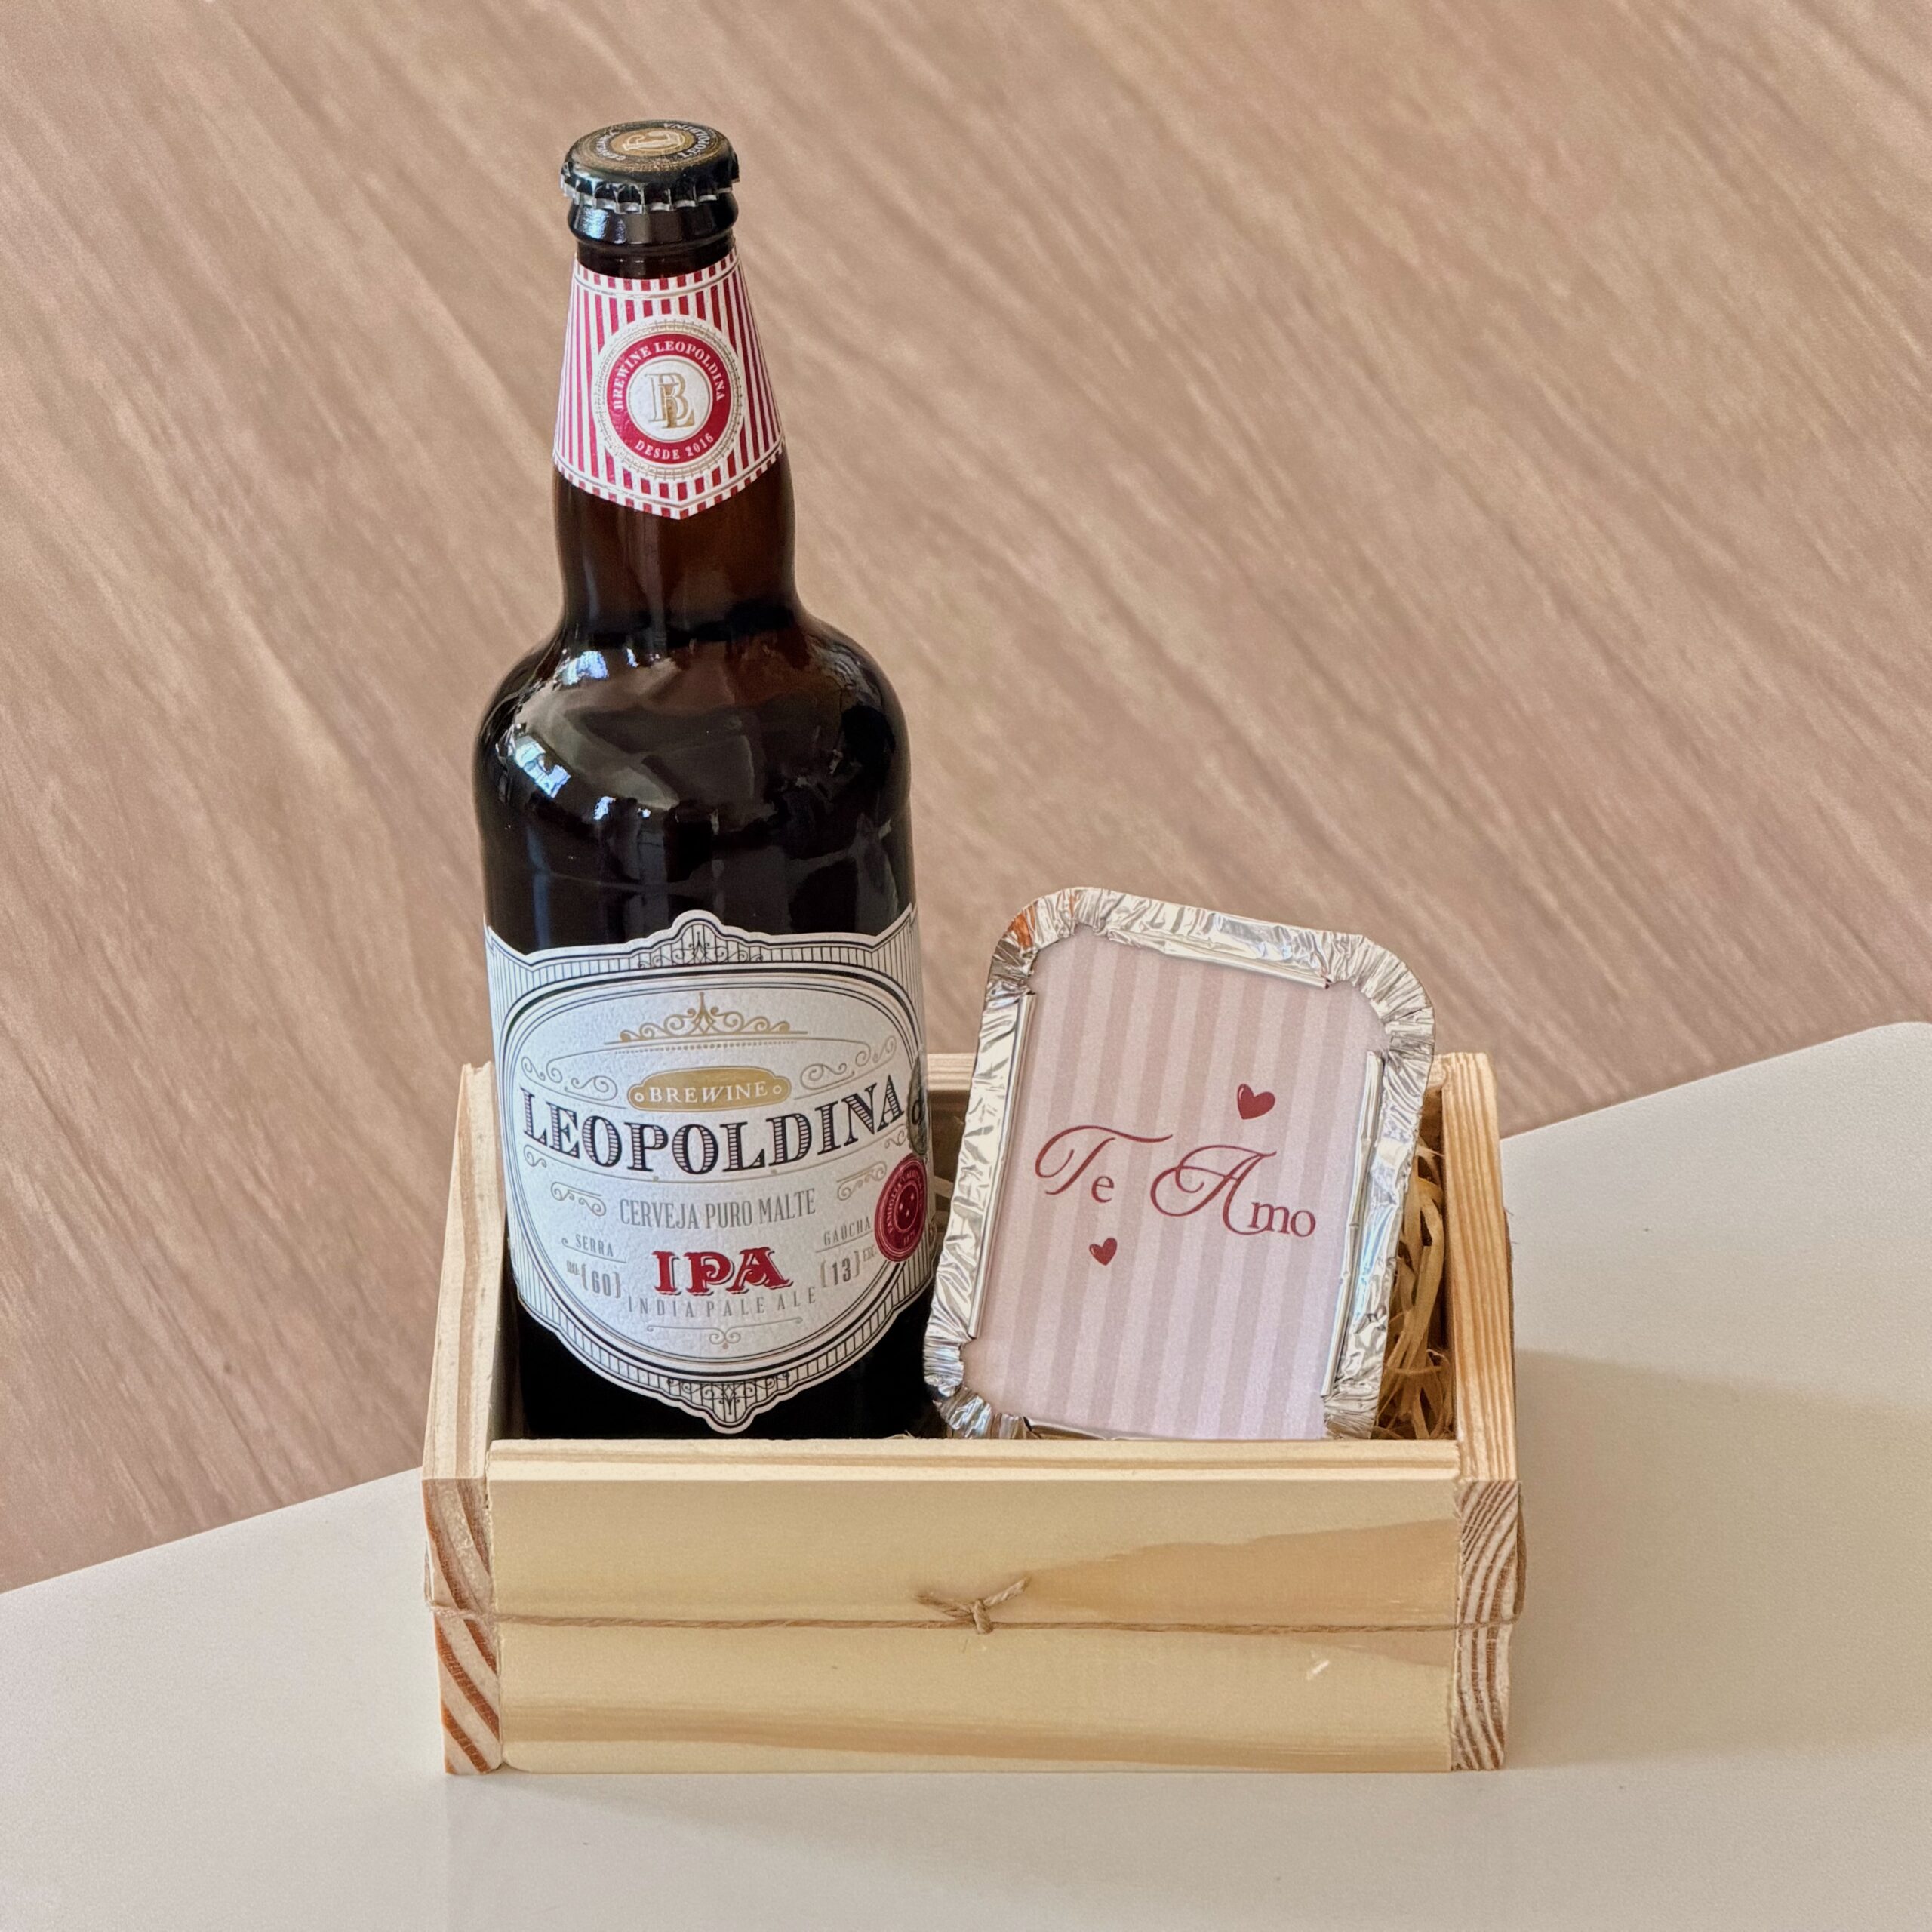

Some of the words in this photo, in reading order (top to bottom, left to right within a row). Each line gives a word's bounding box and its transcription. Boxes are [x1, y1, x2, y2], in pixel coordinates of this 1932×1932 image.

[613, 346, 652, 411] BREWINE
[654, 340, 725, 401] LEOPOLDINA
[635, 439, 680, 460] DESDE
[648, 1081, 768, 1104] BREWINE
[518, 1074, 905, 1175] LEOPOLDINA
[1035, 1124, 1173, 1203] Te
[1150, 1144, 1316, 1238] Amo
[620, 1198, 699, 1229] CERVEJA
[705, 1201, 752, 1229] PURO
[758, 1188, 816, 1224] MALTE
[575, 1234, 614, 1257] SERRA
[652, 1247, 793, 1296] IPA
[629, 1296, 694, 1318] INDIA
[706, 1296, 764, 1318] PALE
[777, 1287, 816, 1311] ALE
